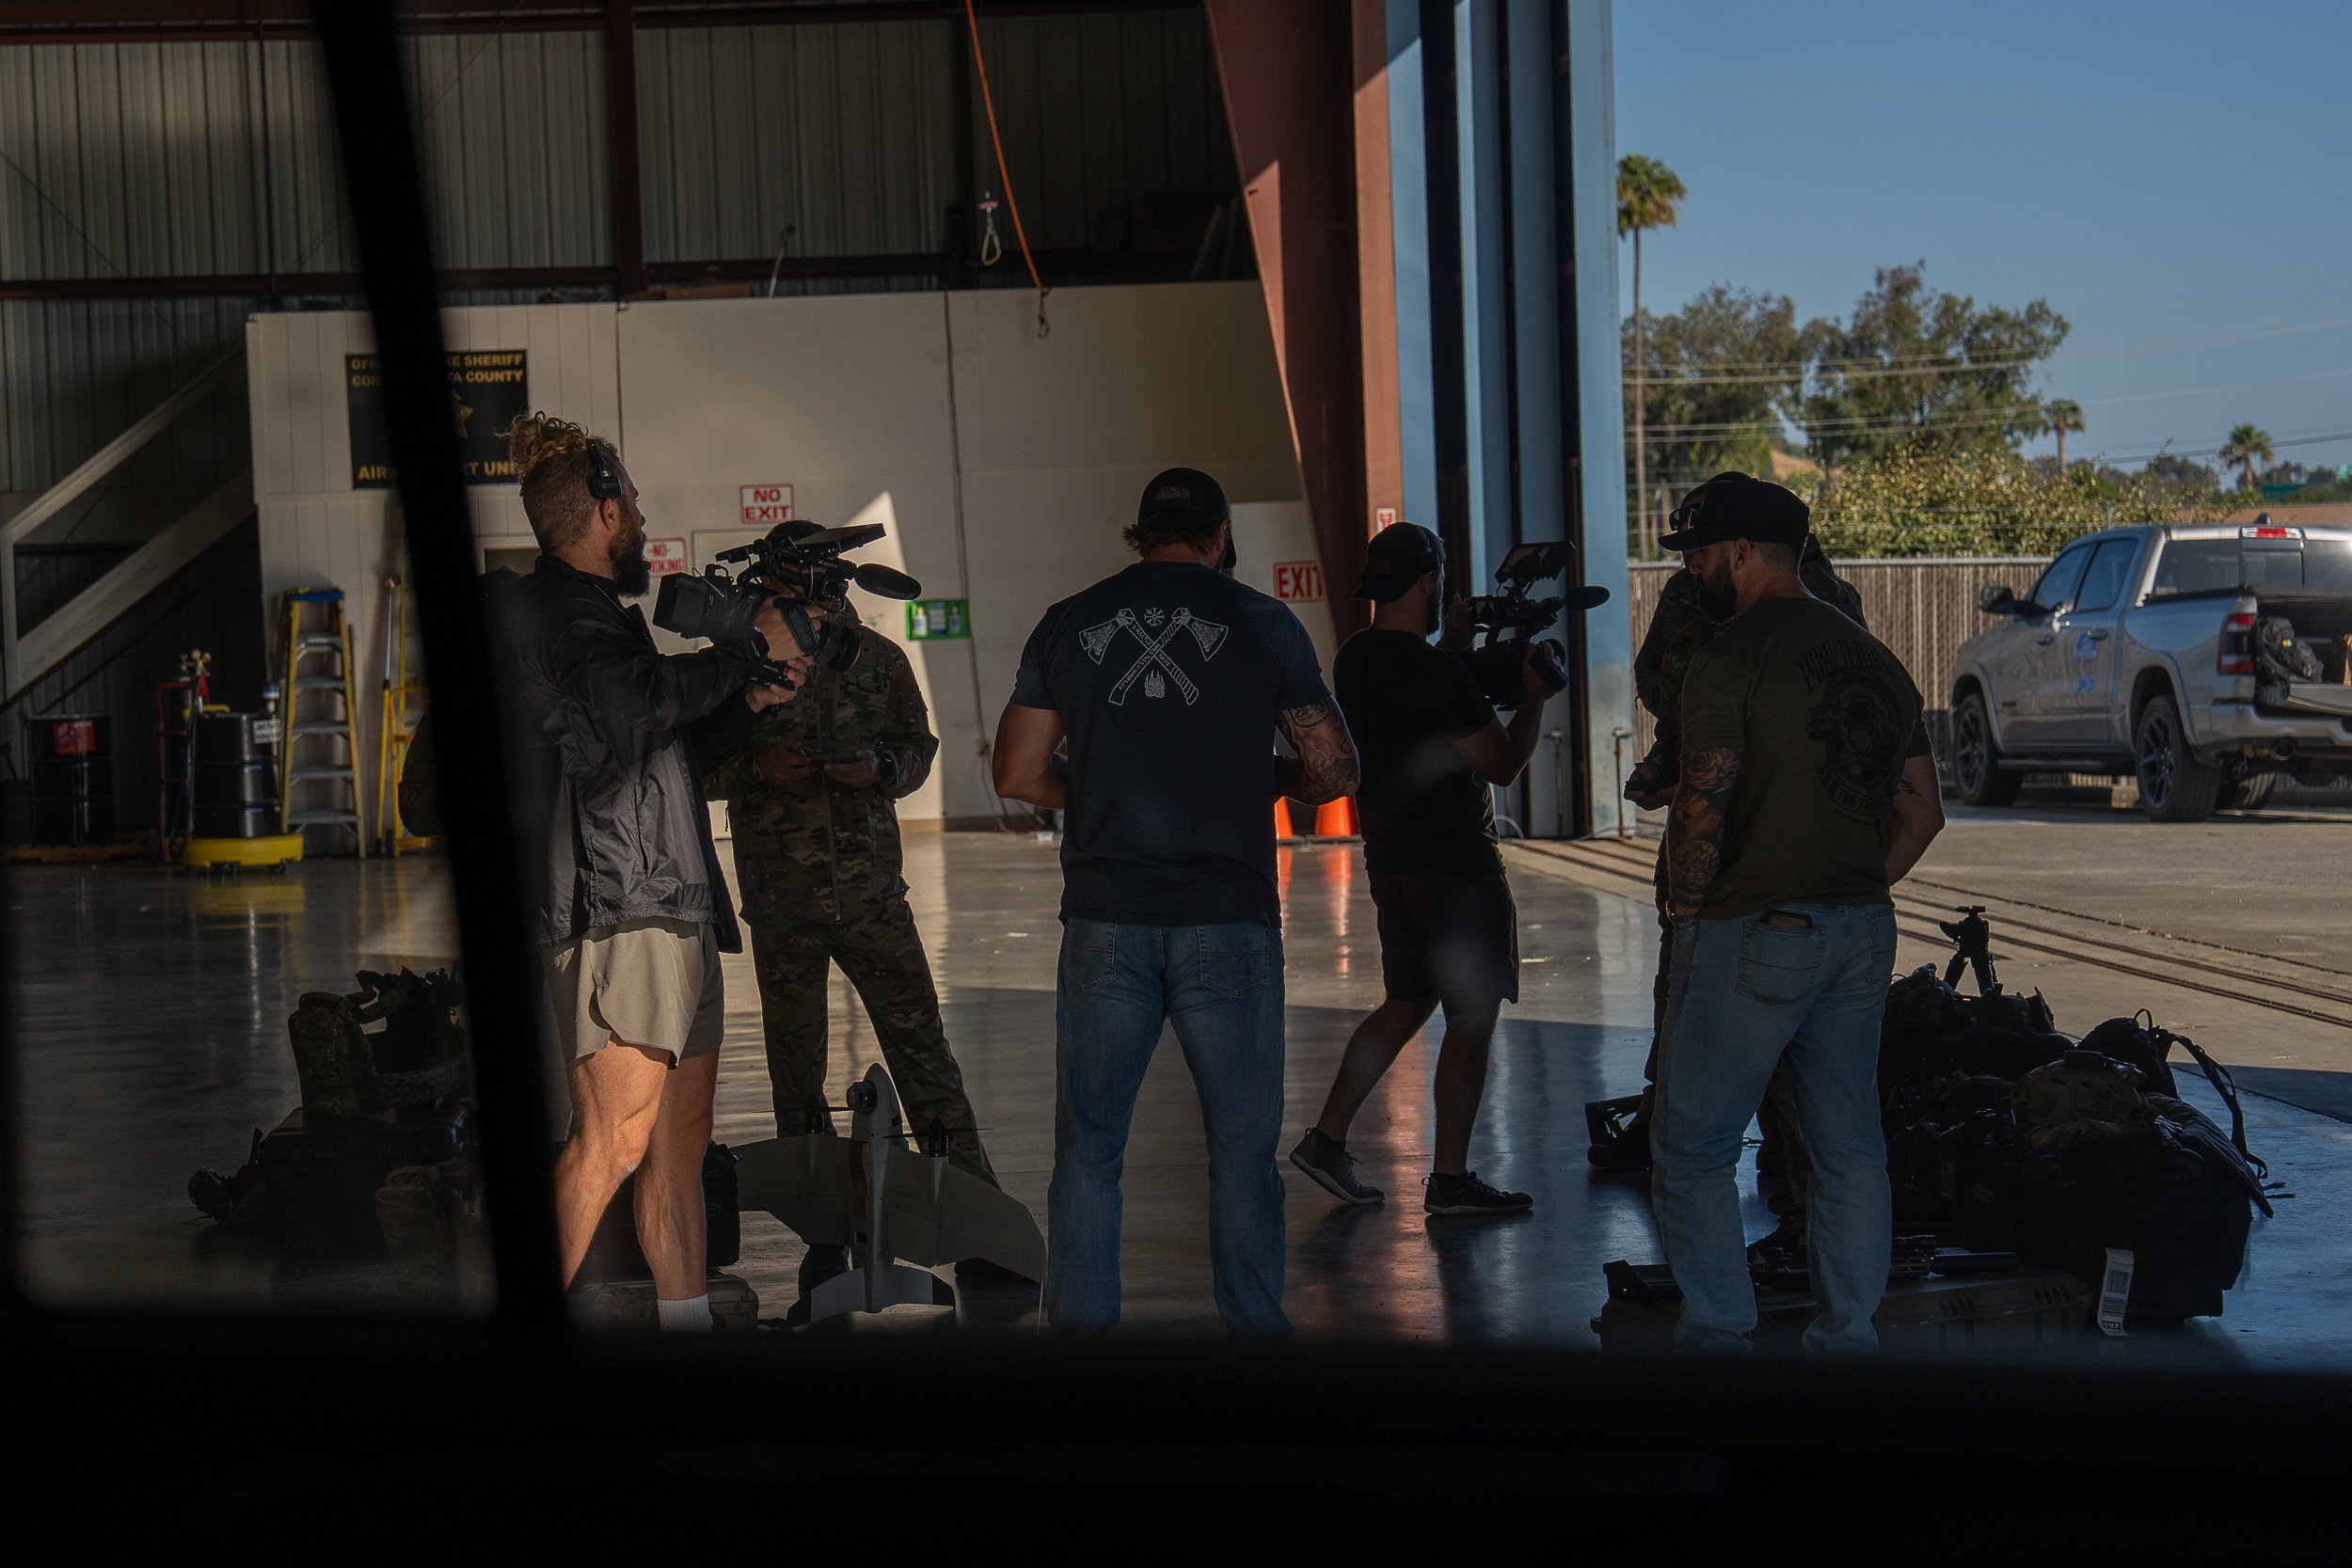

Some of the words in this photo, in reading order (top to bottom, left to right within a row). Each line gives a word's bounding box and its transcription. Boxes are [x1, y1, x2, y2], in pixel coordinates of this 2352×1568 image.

[464, 353, 524, 367] SHERIFF
[466, 369, 524, 383] COUNTY
[357, 465, 389, 482] AIR
[755, 489, 780, 502] NO
[745, 505, 789, 519] EXIT
[1279, 565, 1322, 598] EXIT
